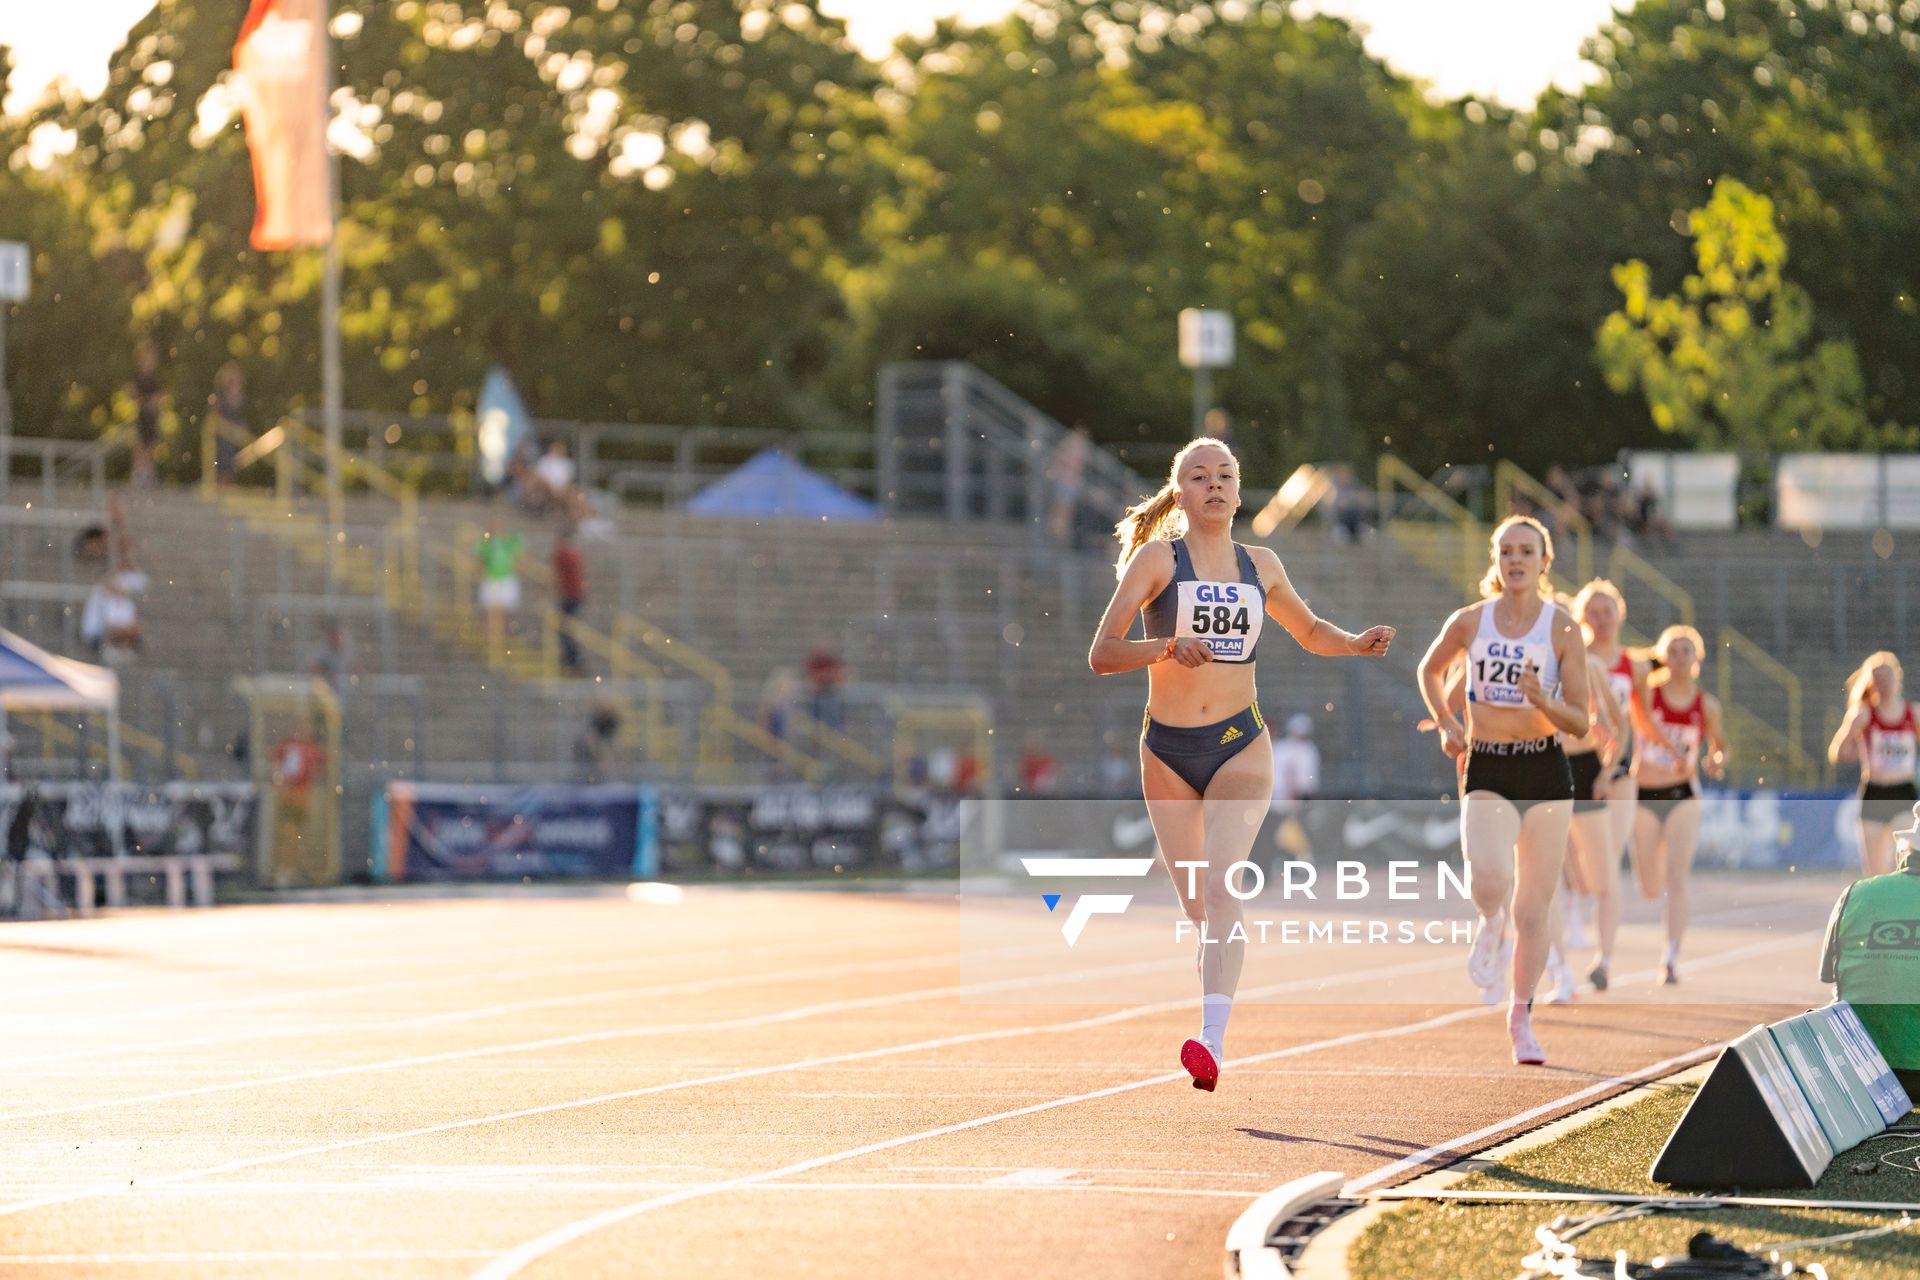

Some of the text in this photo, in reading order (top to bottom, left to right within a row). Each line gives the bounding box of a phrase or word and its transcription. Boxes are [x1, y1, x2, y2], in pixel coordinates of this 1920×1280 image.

[1192, 605, 1250, 635] 584
[1215, 641, 1242, 650] PLAN
[1220, 731, 1244, 745] adidas
[1472, 738, 1509, 756] NIKE
[1512, 736, 1548, 756] PRO
